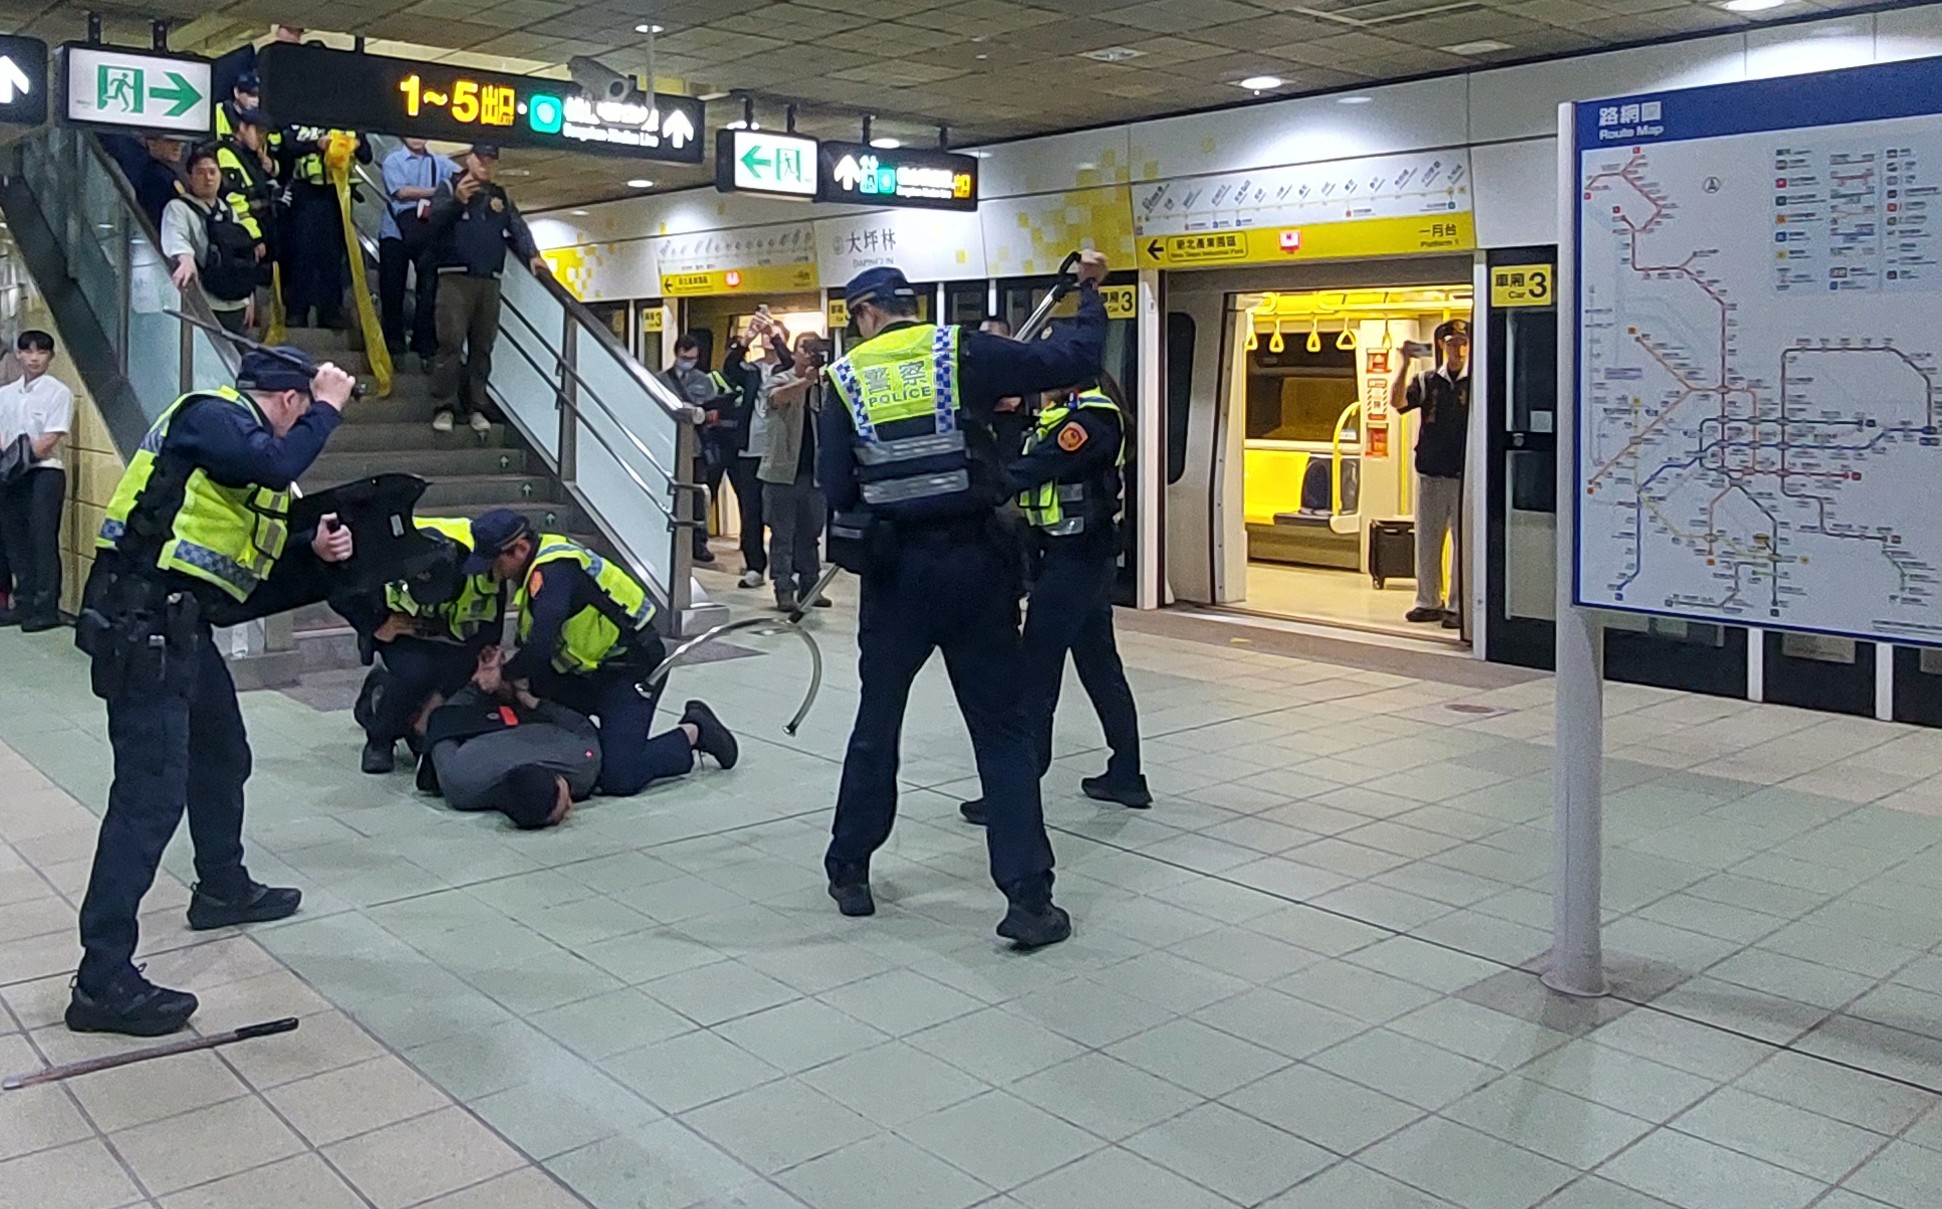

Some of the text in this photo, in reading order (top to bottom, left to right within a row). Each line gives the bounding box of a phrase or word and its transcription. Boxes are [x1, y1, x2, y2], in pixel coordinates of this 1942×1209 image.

[1599, 125, 1664, 140] Route Map
[846, 228, 897, 254] 大坪林
[1419, 223, 1457, 238] 一月台
[1495, 271, 1547, 298] 車廂 3
[1508, 290, 1526, 299] Car
[1121, 291, 1133, 312] 3
[869, 386, 932, 408] POLICE
